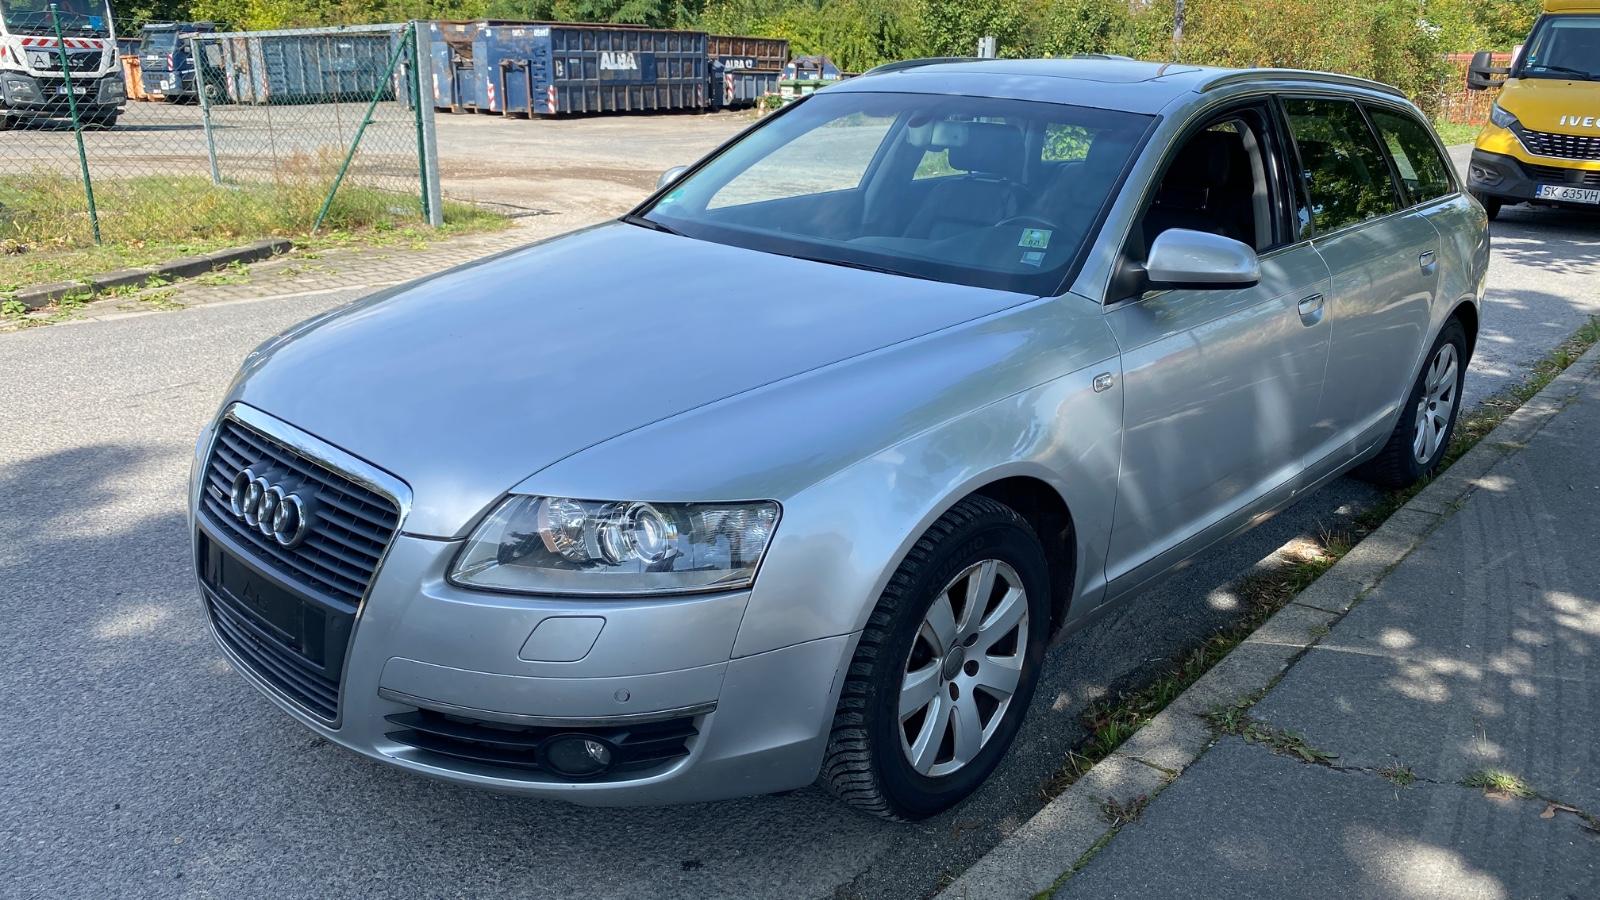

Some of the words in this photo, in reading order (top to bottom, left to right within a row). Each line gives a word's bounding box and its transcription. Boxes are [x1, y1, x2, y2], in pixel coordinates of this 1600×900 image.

[33, 55, 45, 66] A
[725, 59, 745, 68] ALBA
[1544, 186, 1558, 197] SK
[1562, 188, 1599, 201] 635VH
